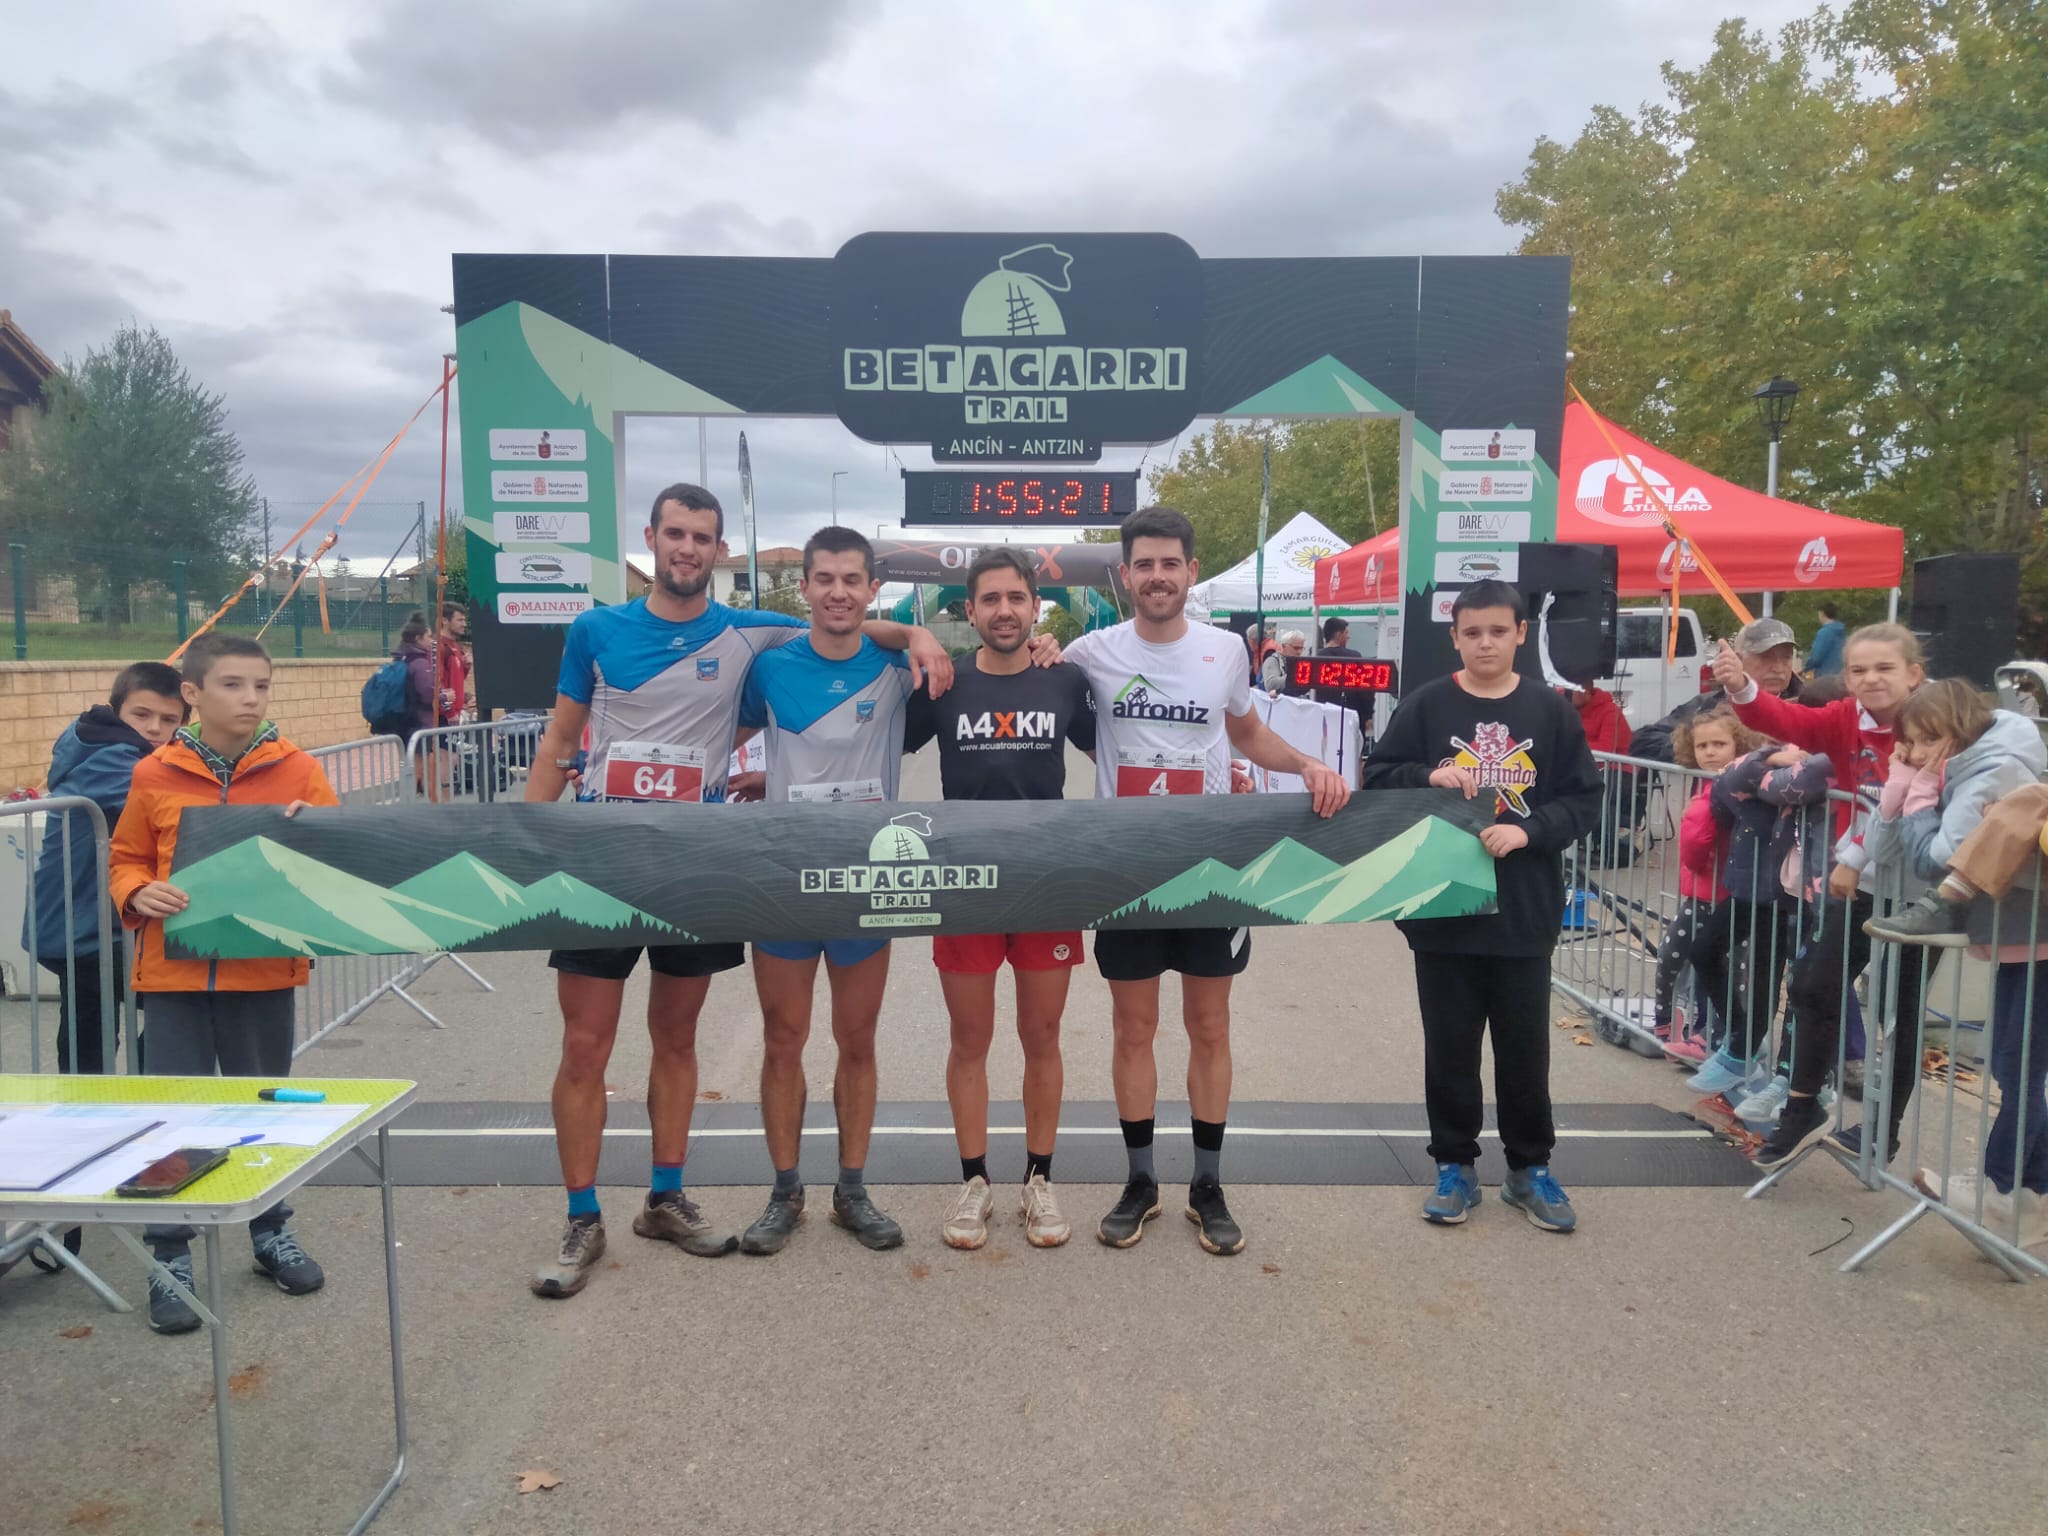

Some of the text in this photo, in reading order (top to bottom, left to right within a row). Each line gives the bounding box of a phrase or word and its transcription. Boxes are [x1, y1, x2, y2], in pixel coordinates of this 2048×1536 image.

[847, 348, 1186, 390] BETAGARRI
[967, 398, 1065, 422] TRAIL
[949, 436, 1003, 455] ANCÍN
[1022, 438, 1085, 455] ANTZIN
[972, 480, 1111, 515] 1:55:21
[1623, 486, 1710, 505] FNA
[1622, 504, 1713, 513] ATLEISMO
[520, 554, 563, 565] CONSTRUCCIONES
[1457, 553, 1501, 563] CONSTRUCCIONES
[520, 571, 564, 582] INSTALACIONES
[521, 601, 585, 611] MAINATE
[1112, 700, 1209, 725] arroniz
[956, 710, 1057, 741] A4XKM
[959, 741, 1053, 753] www.acuatrosport.com
[633, 765, 678, 798] 64
[1148, 771, 1170, 796] 4
[803, 866, 995, 891] BETAGARRI
[872, 894, 930, 908] TRAIL
[903, 915, 933, 924] ANTZIN
